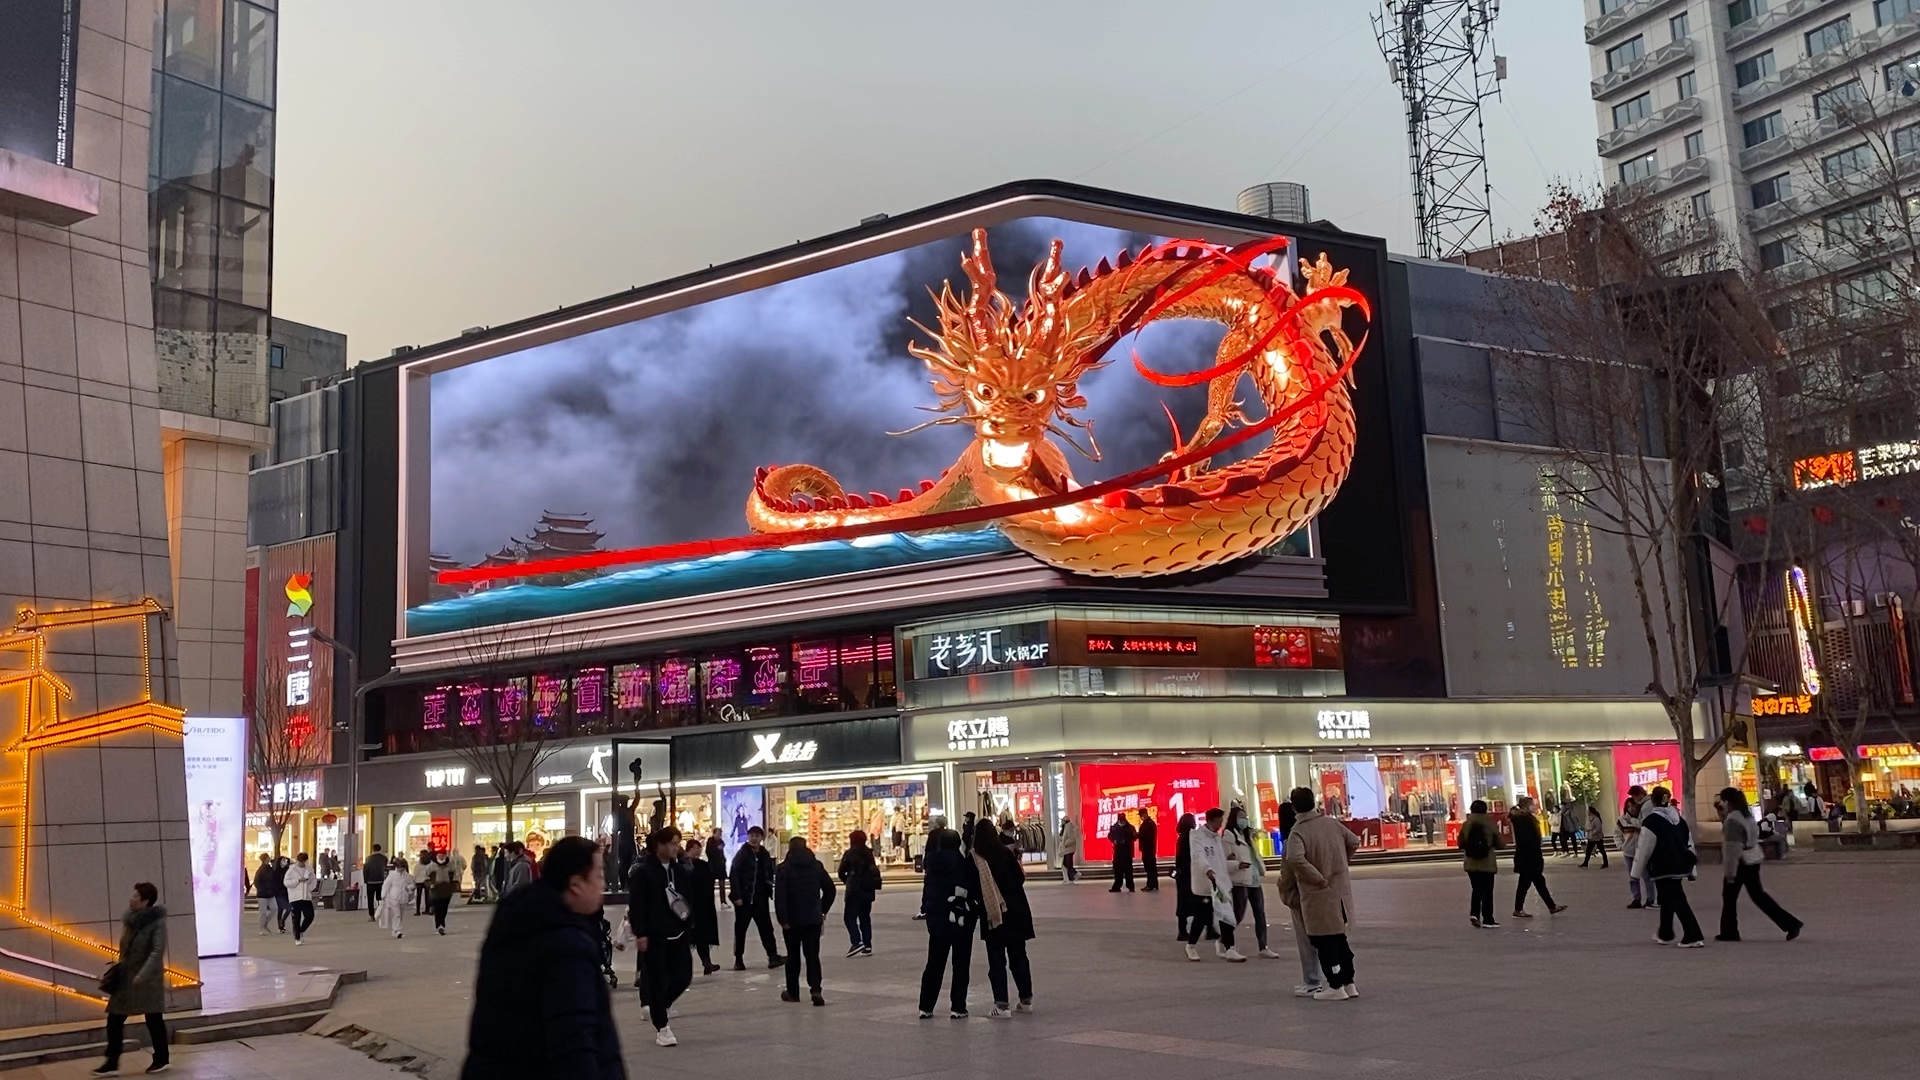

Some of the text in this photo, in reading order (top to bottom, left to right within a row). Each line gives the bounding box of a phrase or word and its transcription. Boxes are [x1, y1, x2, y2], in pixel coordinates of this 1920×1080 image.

[947, 716, 1010, 741] 依立腾
[1317, 710, 1370, 730] 依立腾
[1097, 794, 1139, 813] 依立腾
